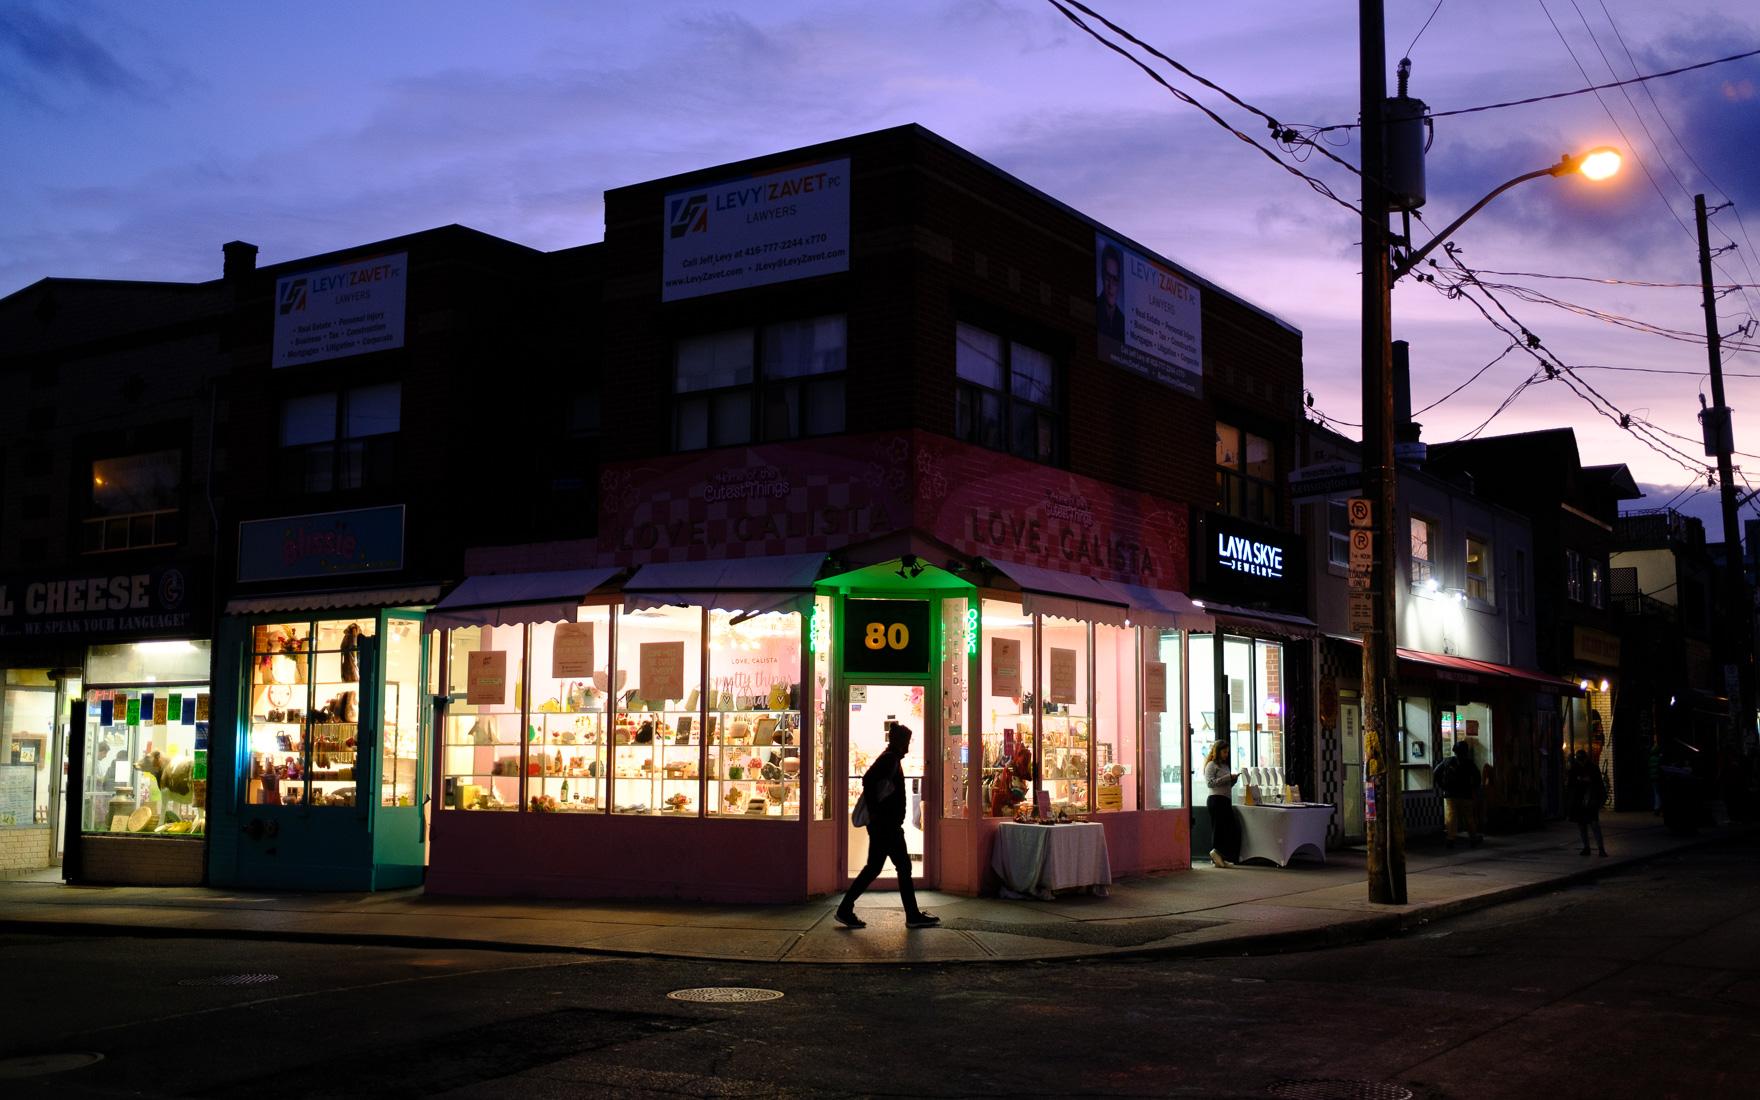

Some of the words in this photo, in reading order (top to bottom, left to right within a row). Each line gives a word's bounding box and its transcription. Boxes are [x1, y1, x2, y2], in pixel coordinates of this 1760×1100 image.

[716, 186, 762, 211] LEVY
[768, 173, 827, 200] ZAVET
[828, 176, 841, 188] PC
[746, 204, 797, 224] LAWYERS
[682, 258, 698, 268] Call
[699, 255, 714, 266] Jeff
[715, 253, 732, 265] Levy
[734, 250, 743, 259] at
[805, 233, 827, 245] x770
[312, 273, 346, 293] LEVY
[350, 264, 392, 286] ZAVET
[665, 267, 743, 287] www.LevyZavet.com
[1130, 258, 1157, 286] LEVY
[1159, 272, 1189, 301] ZAVET
[335, 288, 370, 304] LAWYERS
[703, 484, 746, 503] Cutest
[745, 479, 791, 498] Things
[736, 503, 892, 540] CALISTA
[1061, 528, 1153, 574] CALISTA
[1219, 533, 1253, 562] LAYA
[1253, 542, 1283, 569] SKYE
[1231, 560, 1272, 577] JEWELRY
[25, 574, 151, 616] CHEESE
[24, 622, 42, 634] WE
[44, 619, 81, 633] SPEAK
[84, 617, 115, 632] YOUR
[864, 622, 909, 650] 80
